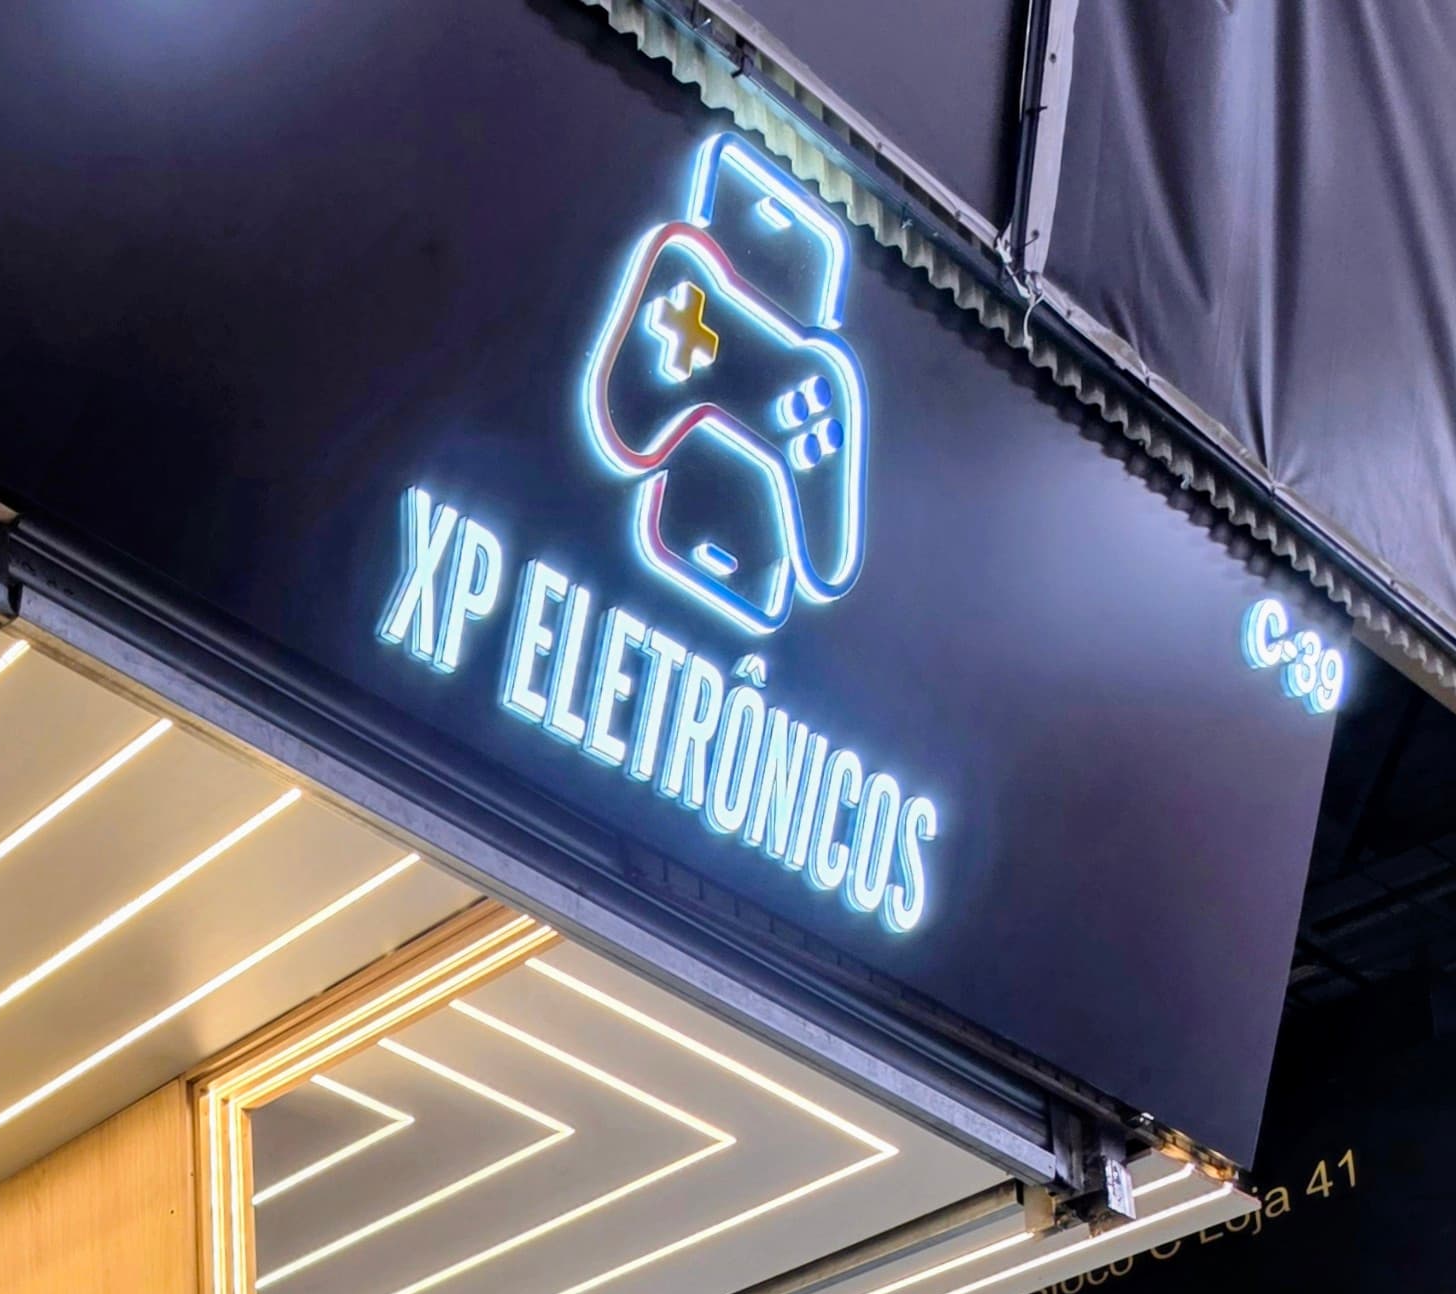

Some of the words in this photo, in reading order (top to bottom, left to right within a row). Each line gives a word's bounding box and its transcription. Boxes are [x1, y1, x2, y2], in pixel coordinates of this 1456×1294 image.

[377, 486, 503, 672] XP
[503, 558, 937, 932] ELETRÔNICOS
[1239, 598, 1346, 714] C-39
[1305, 1149, 1360, 1199] 41
